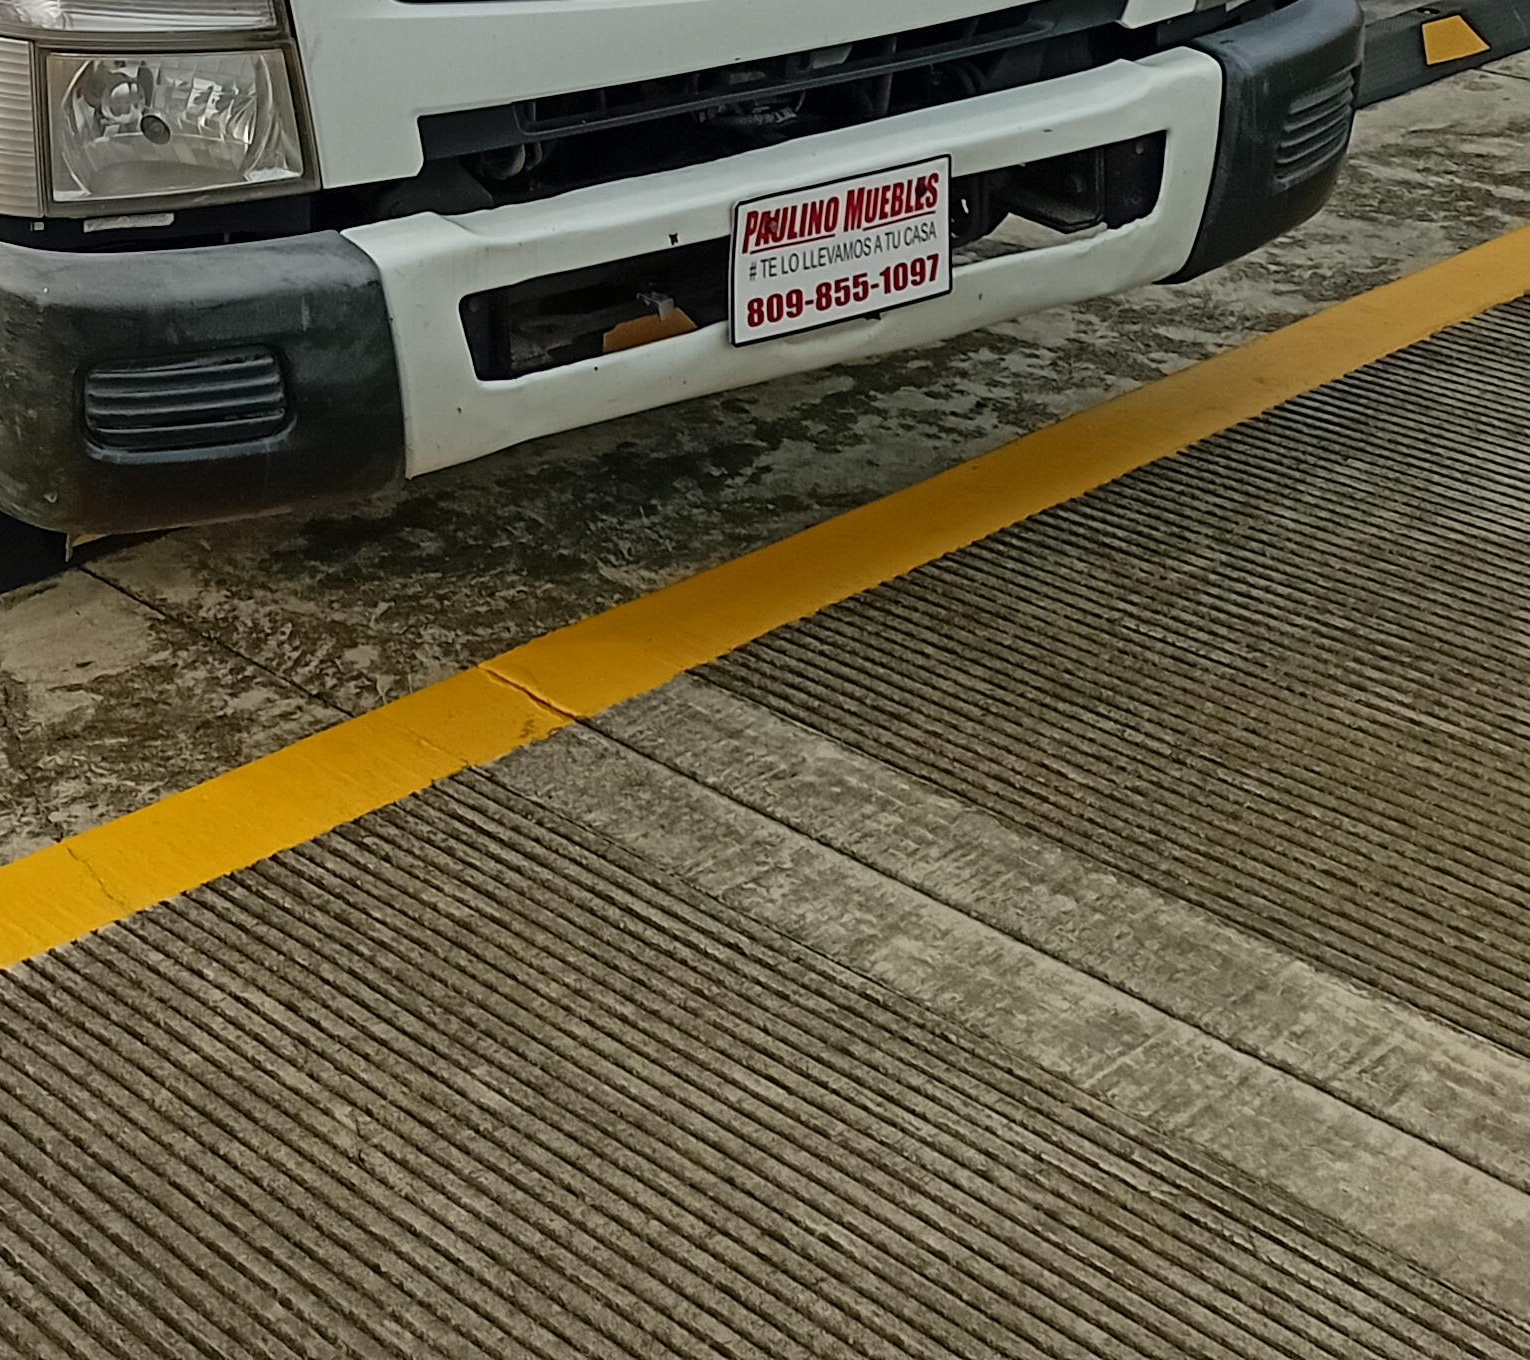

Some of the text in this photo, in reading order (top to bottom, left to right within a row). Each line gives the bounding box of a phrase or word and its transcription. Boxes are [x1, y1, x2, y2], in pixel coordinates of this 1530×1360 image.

[741, 172, 940, 254] PAULINO MUEBLES
[760, 256, 778, 279] TE
[781, 251, 801, 274] LO
[803, 237, 872, 271] LLEVAMOS
[873, 233, 884, 254] A
[885, 229, 902, 251] TU
[904, 221, 938, 247] CASA
[746, 253, 940, 328] 809-855-1097
